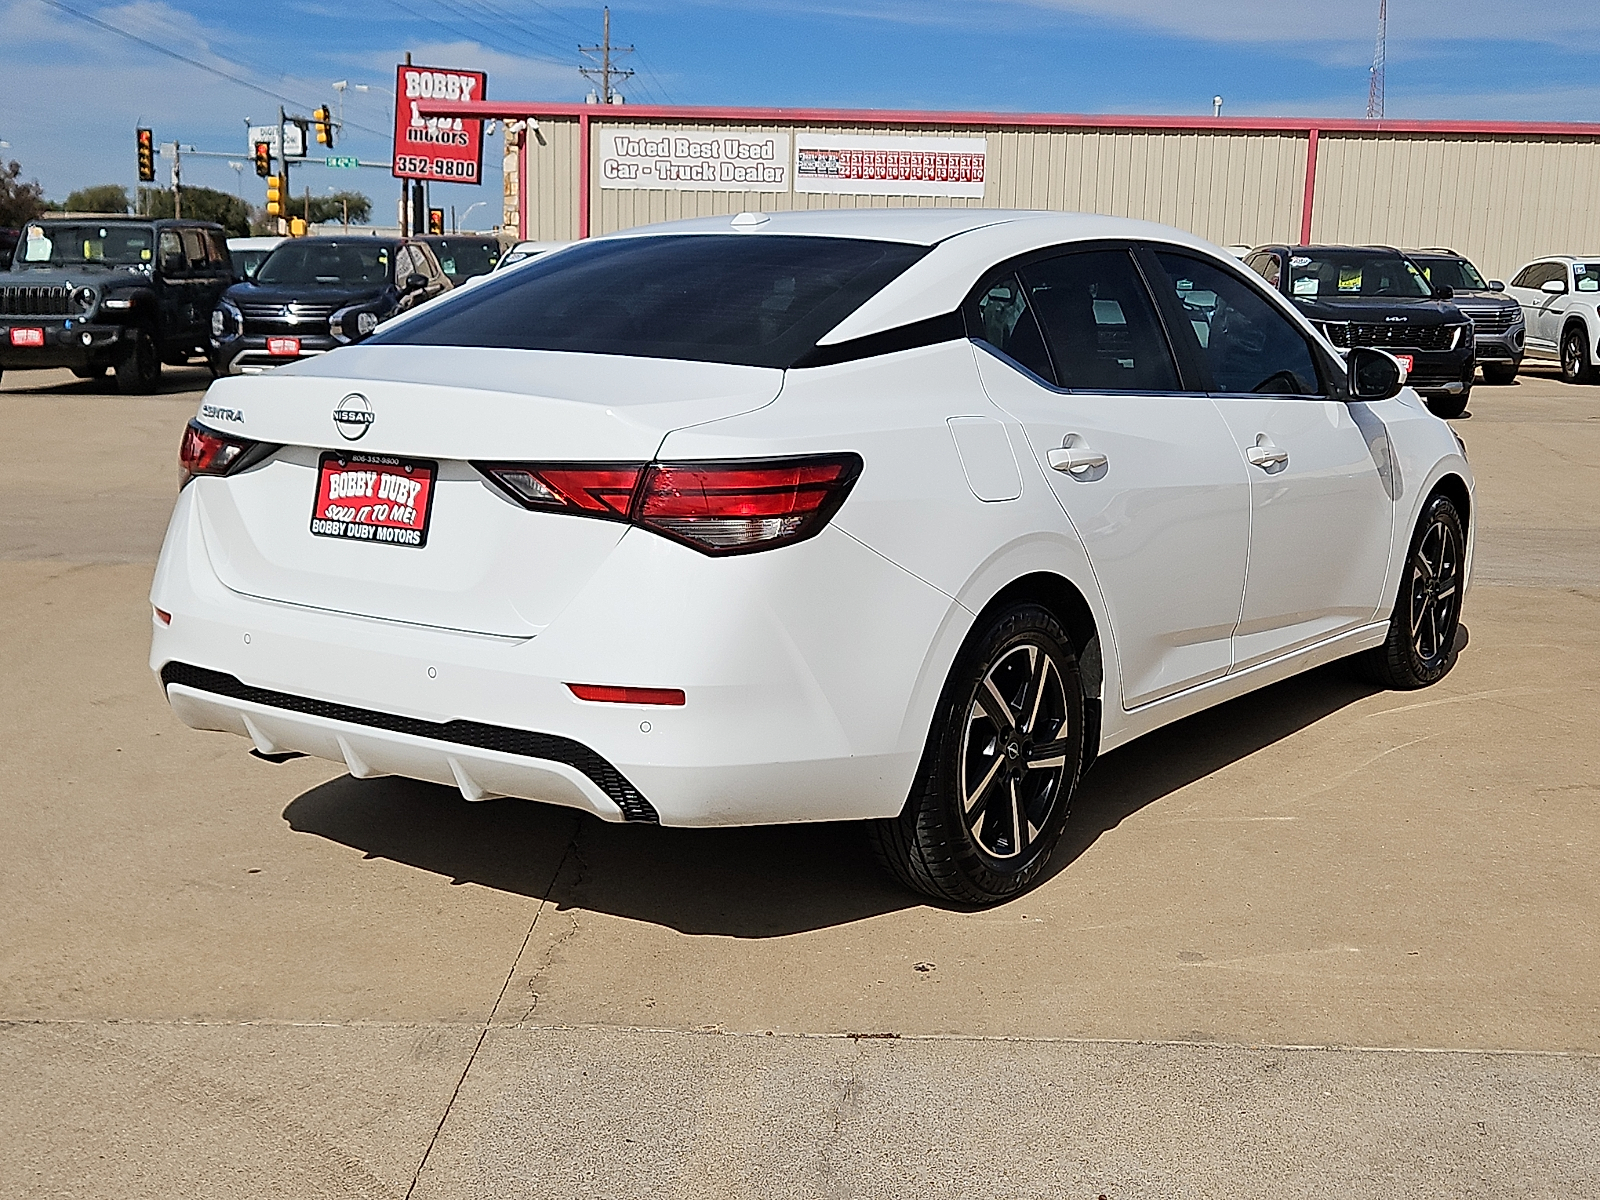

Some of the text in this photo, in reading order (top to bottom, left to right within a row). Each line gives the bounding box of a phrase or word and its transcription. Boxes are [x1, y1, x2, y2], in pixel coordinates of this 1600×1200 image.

[405, 71, 476, 101] BOBBY
[614, 136, 670, 157] Voted
[674, 138, 720, 159] Best
[724, 139, 774, 160] Used
[397, 156, 475, 178] 352-9800
[604, 159, 638, 179] Car
[655, 160, 715, 181] Truck
[720, 162, 784, 183] Dealer
[203, 404, 245, 423] SENTRA
[333, 410, 375, 423] NISSAN
[328, 470, 422, 508] BOBBY DUBY
[325, 504, 418, 526] SOLD IT TO ME!
[312, 518, 421, 545] BOBBY DUBY MOTORS
